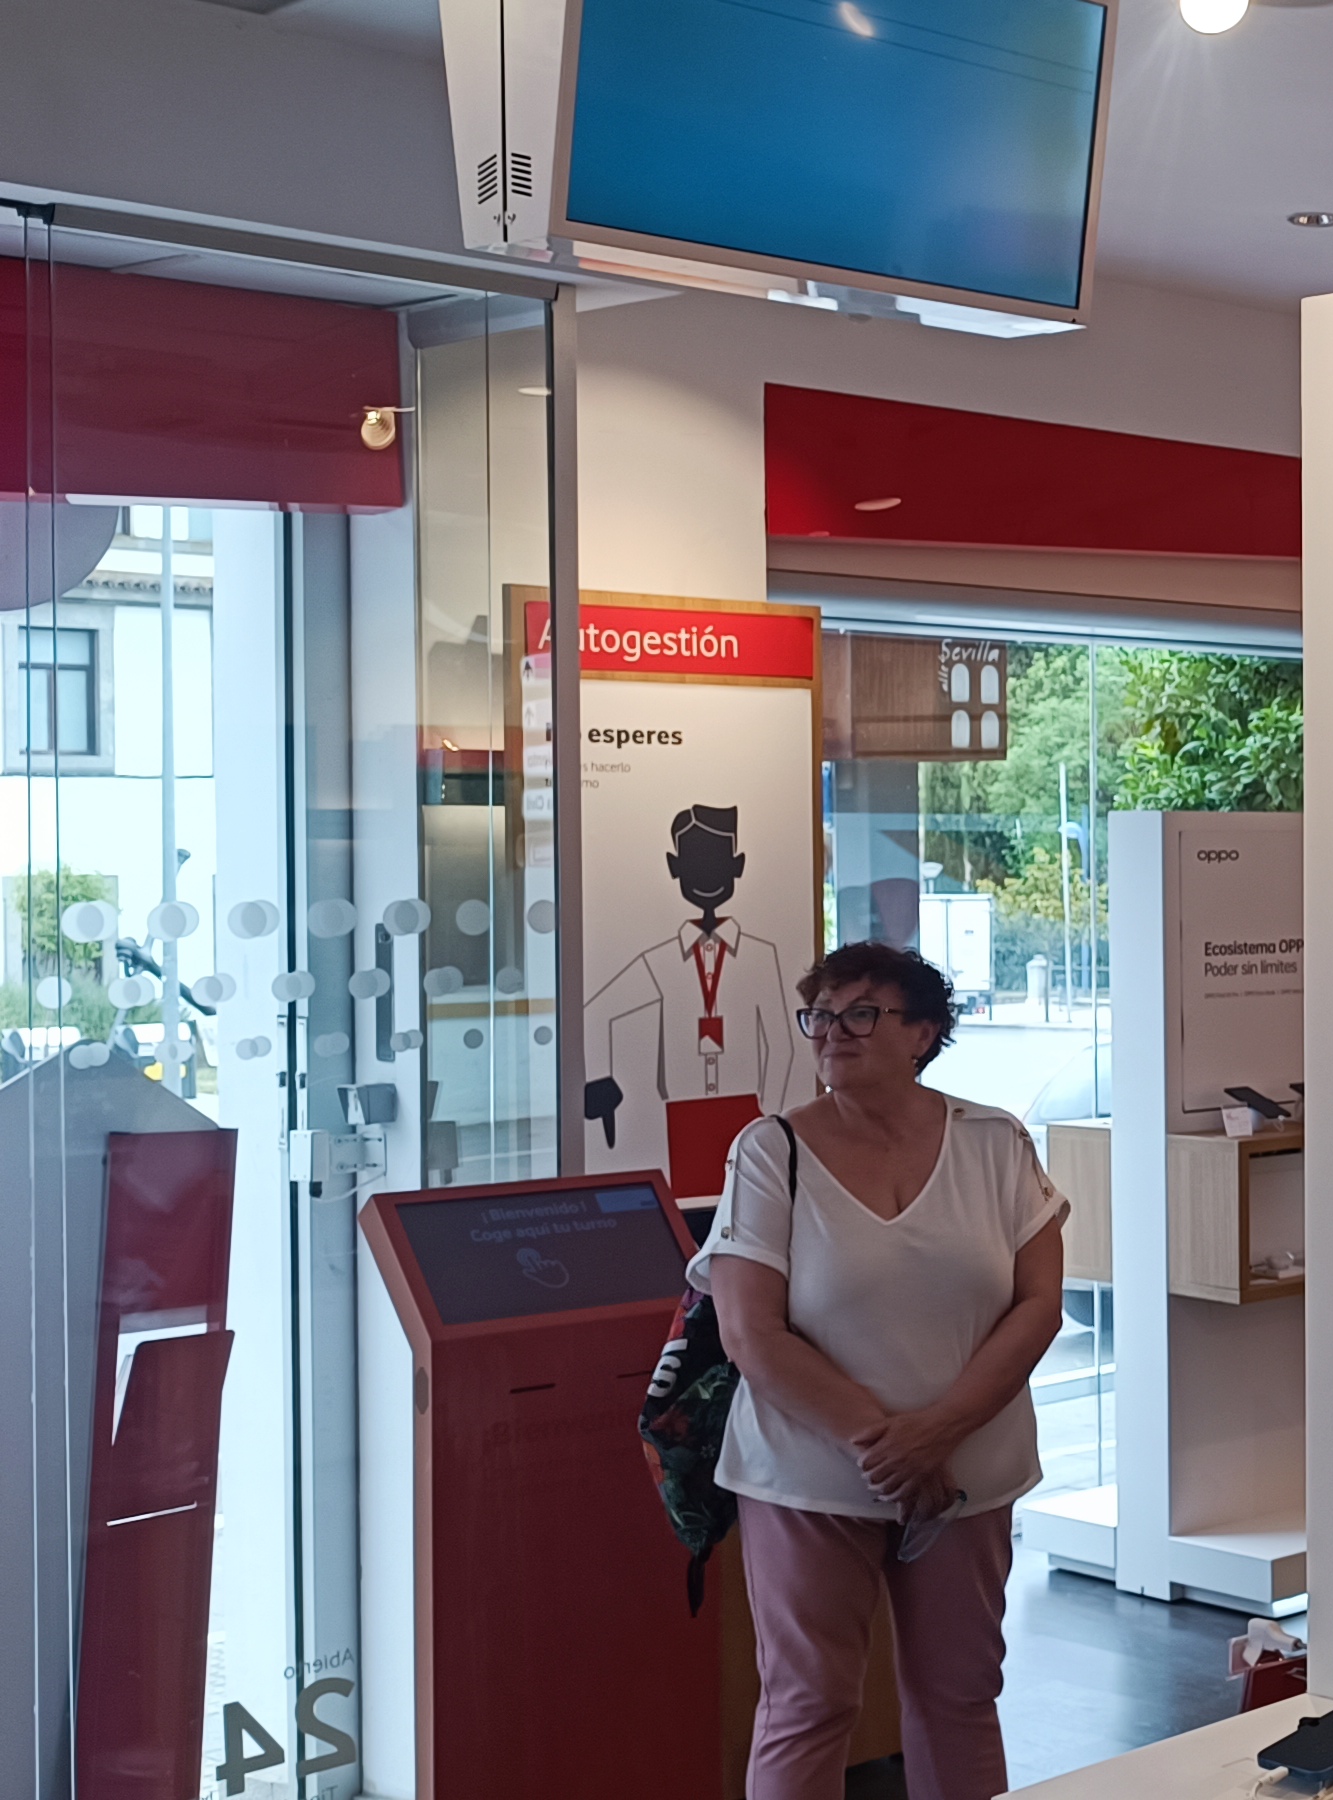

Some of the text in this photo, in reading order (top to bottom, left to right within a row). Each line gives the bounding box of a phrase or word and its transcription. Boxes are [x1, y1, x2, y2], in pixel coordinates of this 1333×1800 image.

[538, 618, 739, 662] Atogestión
[942, 638, 1000, 662] Sevilla
[588, 727, 683, 748] esperes
[591, 761, 631, 773] hacerlo
[1197, 850, 1239, 864] oppo
[1204, 938, 1304, 957] Ecosistema OPP
[1204, 961, 1238, 977] Poder
[1241, 960, 1258, 975] sin
[470, 1218, 618, 1243] Coge aquí tu turno
